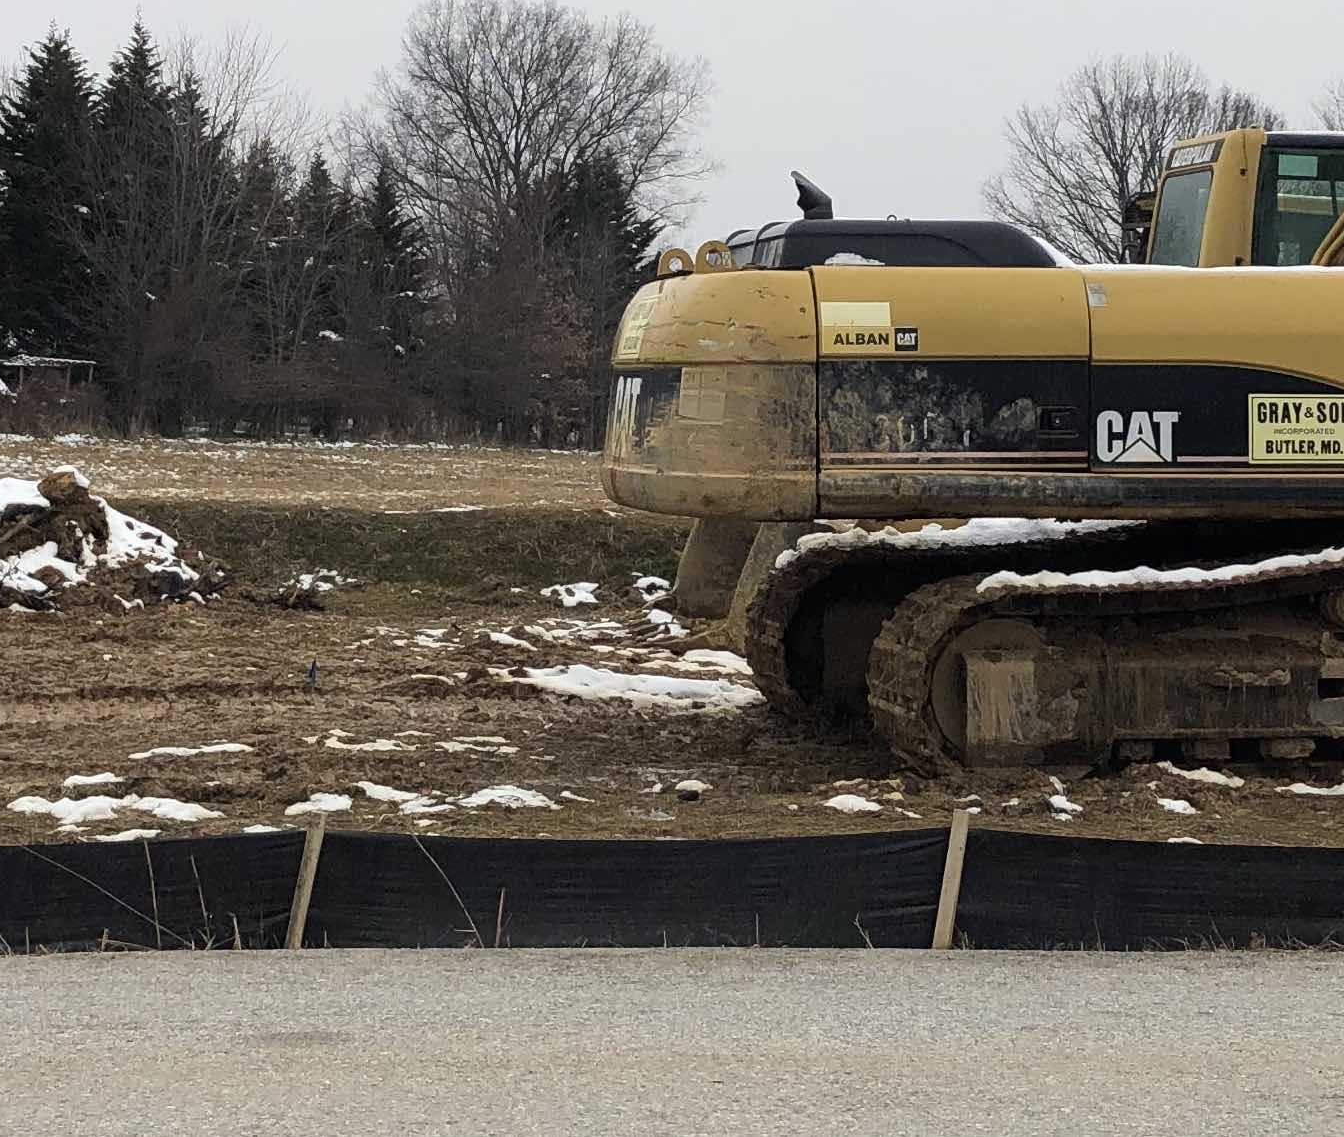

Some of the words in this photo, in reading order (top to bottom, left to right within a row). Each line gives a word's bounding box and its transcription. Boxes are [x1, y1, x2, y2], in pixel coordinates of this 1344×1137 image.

[833, 333, 890, 345] ALBAN
[896, 332, 917, 346] CAT
[1257, 402, 1302, 424] GRAY
[1097, 410, 1179, 462] CAT
[1265, 440, 1318, 456] BUTLER,
[1320, 440, 1344, 455] MD.
